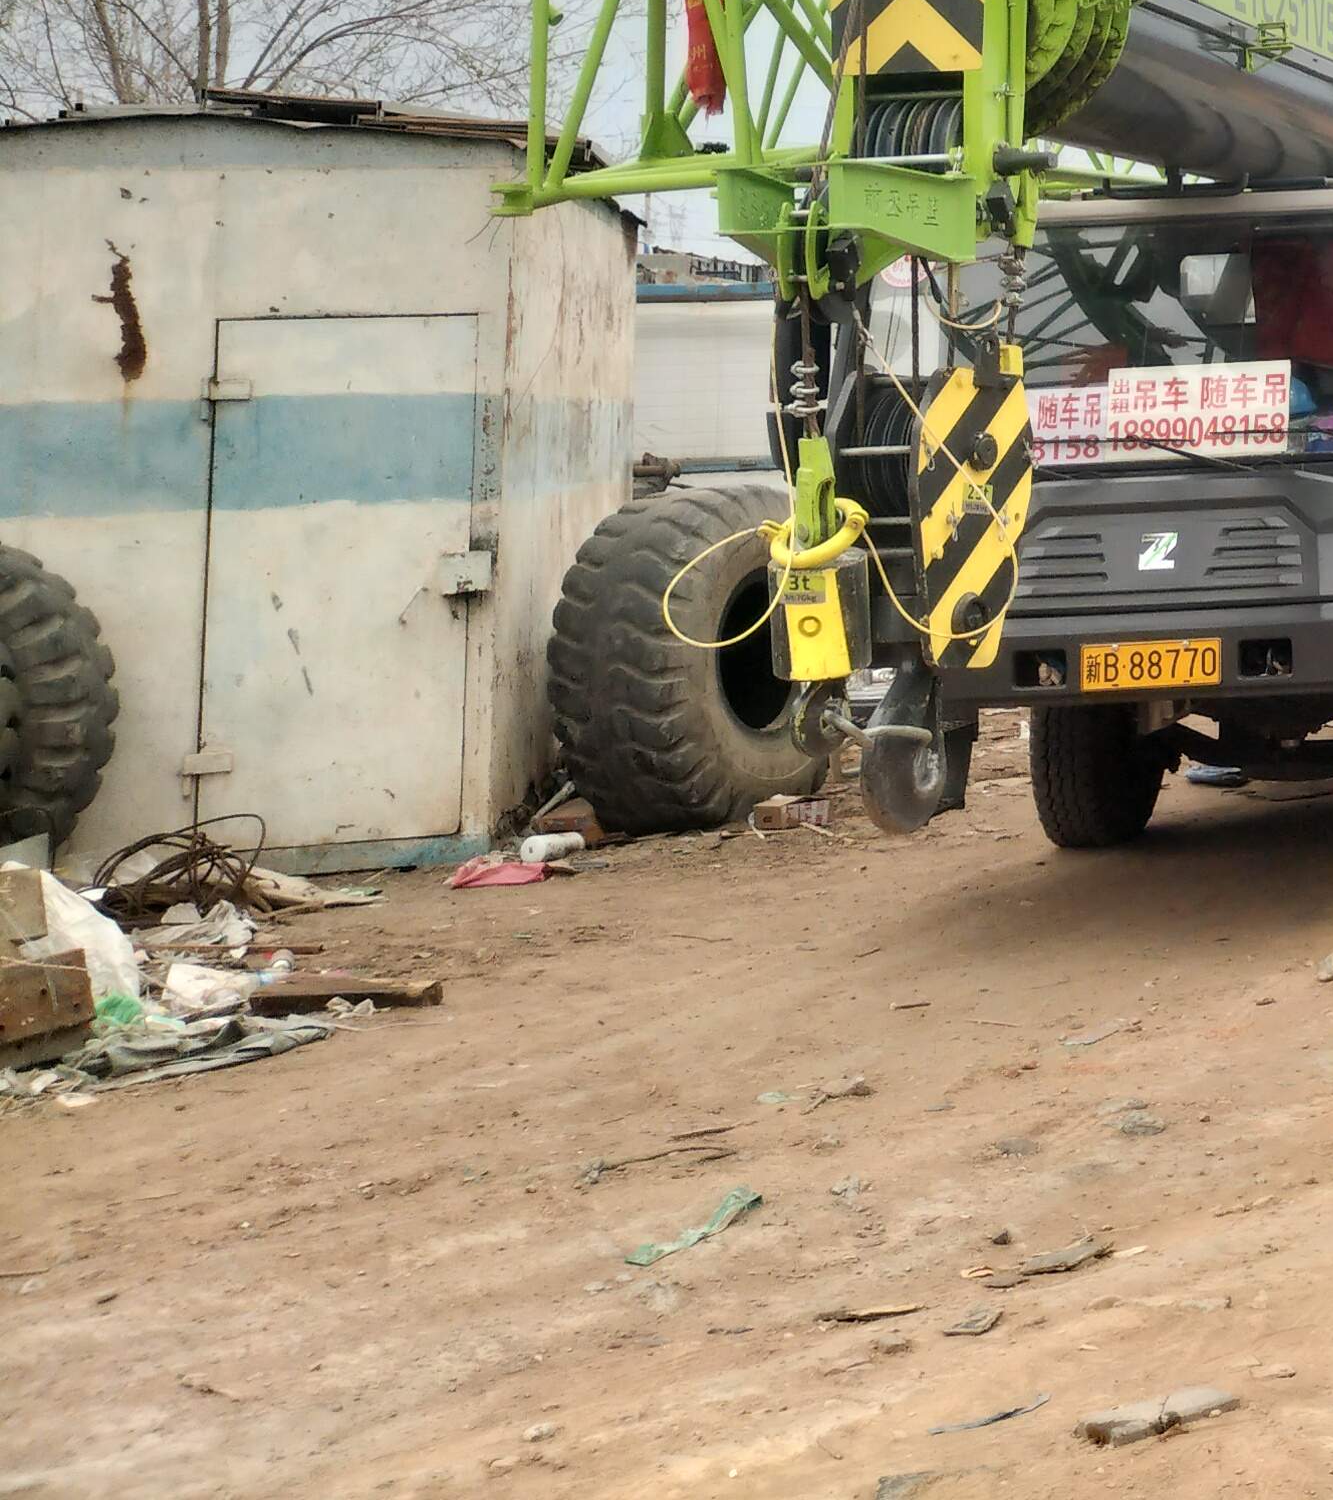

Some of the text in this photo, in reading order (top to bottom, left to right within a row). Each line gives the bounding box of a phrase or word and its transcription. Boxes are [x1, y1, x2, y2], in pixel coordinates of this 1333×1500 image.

[1037, 392, 1101, 431] 随车吊
[1133, 373, 1286, 413] 吊车 随车吊
[1108, 412, 1286, 452] 18899048158
[788, 574, 811, 591] 3t
